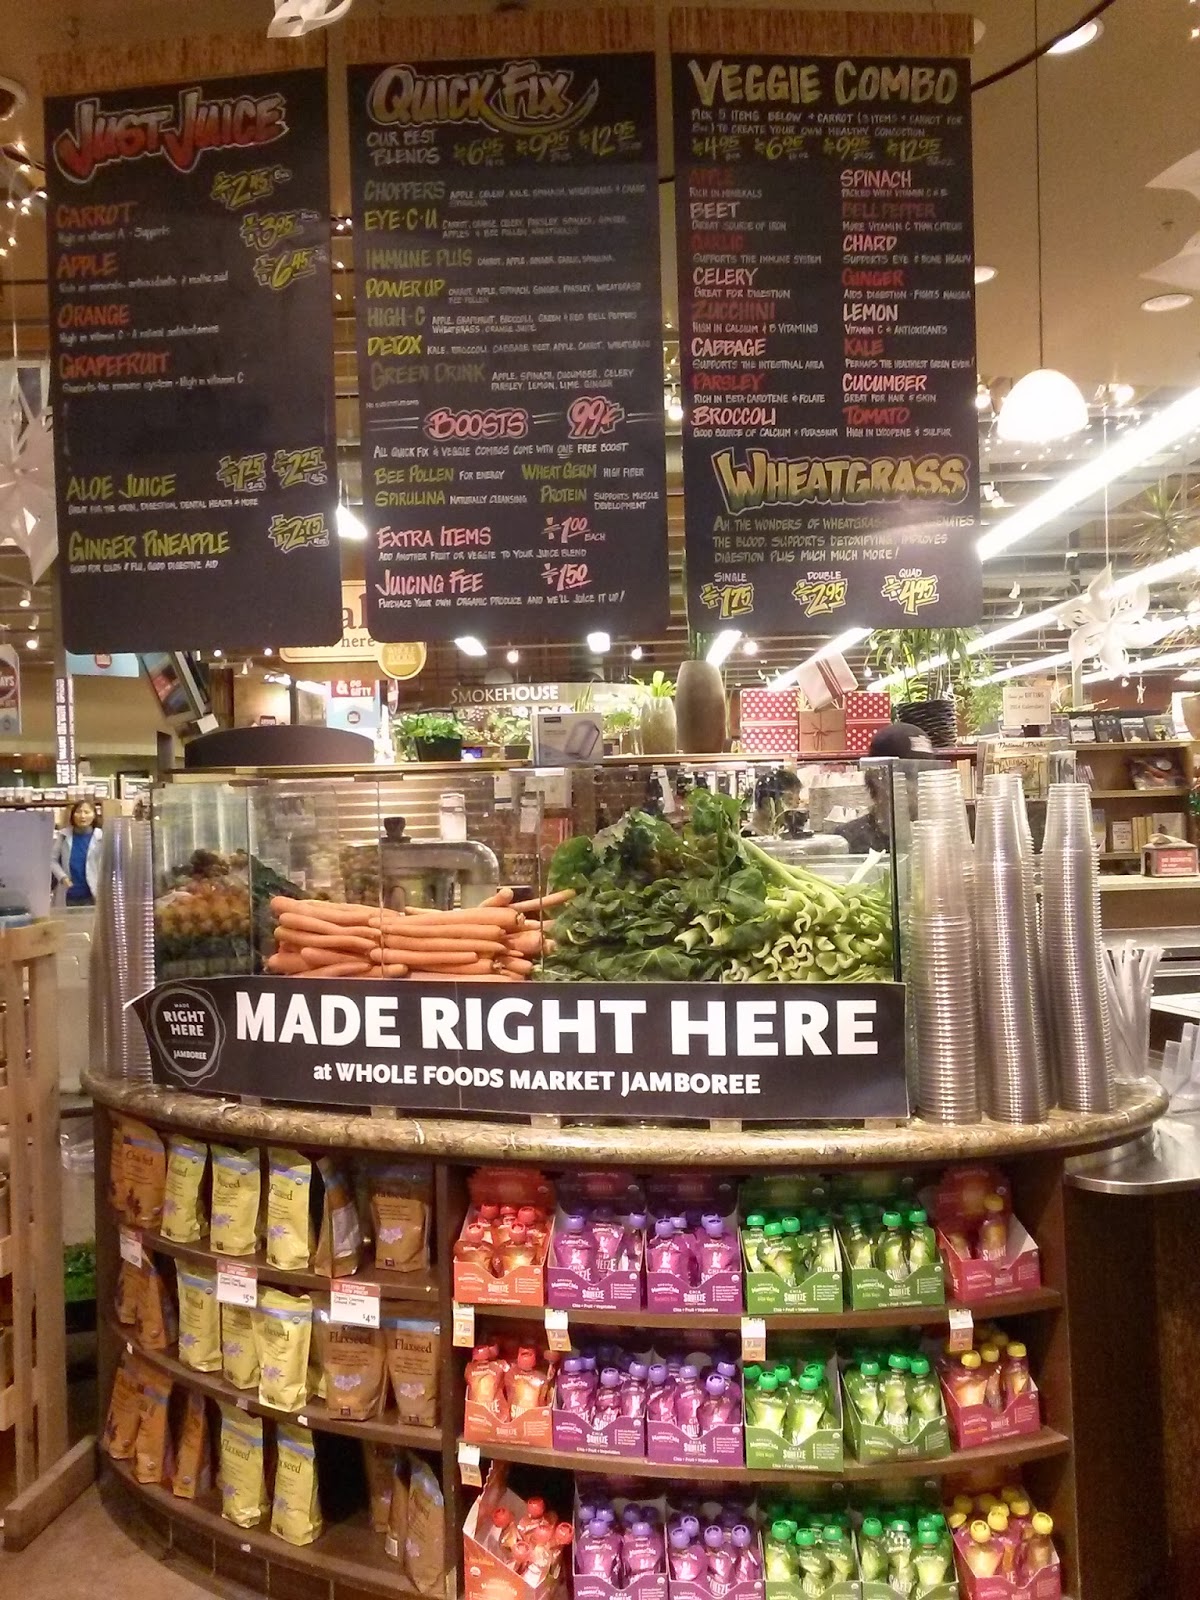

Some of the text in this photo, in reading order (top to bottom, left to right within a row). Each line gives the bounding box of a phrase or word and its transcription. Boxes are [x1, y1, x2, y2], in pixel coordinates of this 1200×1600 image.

[688, 59, 958, 107] VEGGIE COMBO
[369, 59, 573, 127] QUICK FIX
[731, 110, 853, 123] ITEMS BELOW CARROT
[55, 87, 289, 184] JUST JUICE
[367, 129, 437, 146] OUR BEST
[731, 125, 795, 134] CREATE YOUR
[370, 147, 440, 167] BLENDS
[840, 169, 912, 188] SPINACH
[364, 180, 446, 201] CHOPPERS
[56, 201, 139, 229] CARROT
[690, 202, 740, 219] BEET
[842, 234, 897, 252] CHARD
[56, 252, 118, 279] APPLE
[366, 248, 473, 270] IMMUNE PLUS
[692, 253, 738, 264] SUPPORTS
[843, 254, 889, 264] SUPPORTS
[693, 267, 759, 286] CELERY
[842, 267, 905, 286] GINGER
[365, 277, 446, 299] POWER UP
[694, 287, 790, 299] GREAT FOR DIGESTION
[843, 289, 863, 299] AIDS
[58, 303, 130, 329] ORANGE
[691, 300, 775, 320] ZUCCHINI
[843, 303, 898, 321] LEMON
[693, 322, 818, 333] HIGH CALCIUM VITAMINS
[894, 325, 948, 335] ANTIOXIDANTS
[367, 335, 422, 356] DETOX
[691, 337, 766, 357] CABBAGE
[844, 338, 884, 357] KALE
[59, 351, 171, 379] GRAPEFRUIT
[692, 359, 738, 369] SUPPORTS
[371, 361, 486, 391] GREEN DRINK
[691, 373, 765, 391] PARSLEY
[842, 373, 928, 392] CUCUMBER
[694, 394, 825, 404] RICH FOLATE
[843, 393, 885, 403] GREAT FOR
[425, 408, 527, 440] BOOSTS
[690, 405, 776, 426] BROCCOLI
[842, 405, 911, 425] TOMATO
[693, 427, 838, 438] GOOD CALCIUM POTASSIUM
[846, 428, 863, 438] HIGH
[373, 443, 629, 458] ALL QUICK FIX VEGGIE COMBOS COME WITH FREE BOOST
[374, 462, 645, 485] BEE POLLEN FOR ENERGY WHEAT GERM HIGH FIBER
[713, 448, 970, 514] WHEATGRASS
[66, 473, 177, 499] ALOE JUICE
[375, 485, 659, 507] SPIRULINA NATURALLY CLEANSING PROTEIN SUPPORTS MUSCLE
[595, 501, 647, 511] DEVELOPMENT
[713, 516, 820, 532] AH THE WONDERS OF
[68, 529, 230, 562] GINGER PINEAPPLE
[376, 526, 606, 549] EXTRA ITEMS EACH
[713, 535, 825, 548] THE SUPPORTS
[379, 548, 587, 561] ADD ANOTHER FRUIT OR VEGGIE TO YOUR JUICE BLEND
[714, 549, 858, 563] DIGESTION PLUS MUCH MUCH
[375, 569, 483, 596] JUICING FEE
[714, 568, 922, 582] SINGLE DOUBLE QUAD
[414, 596, 543, 607] YOUR ORGANIC PRODUCE AND
[341, 637, 375, 648] here
[450, 685, 559, 704] SMOKEHOUSE
[162, 1010, 206, 1023] RIGHT
[235, 990, 879, 1057] MADE RIGHT HERE
[170, 1024, 205, 1037] HERE
[173, 1050, 207, 1060] JAMBOREE
[313, 1062, 761, 1098] at WHOLE FOODS MARKET JAMBOREE
[582, 1290, 604, 1300] SQUEEZE
[683, 1293, 706, 1302] SQUEEZE
[784, 1293, 807, 1302] SQUEEZE
[329, 1331, 371, 1345] Flaxseed
[395, 1338, 432, 1354] Flaxseed
[586, 1435, 609, 1445] SQUEEZE
[684, 1444, 707, 1453] SQUEEZE
